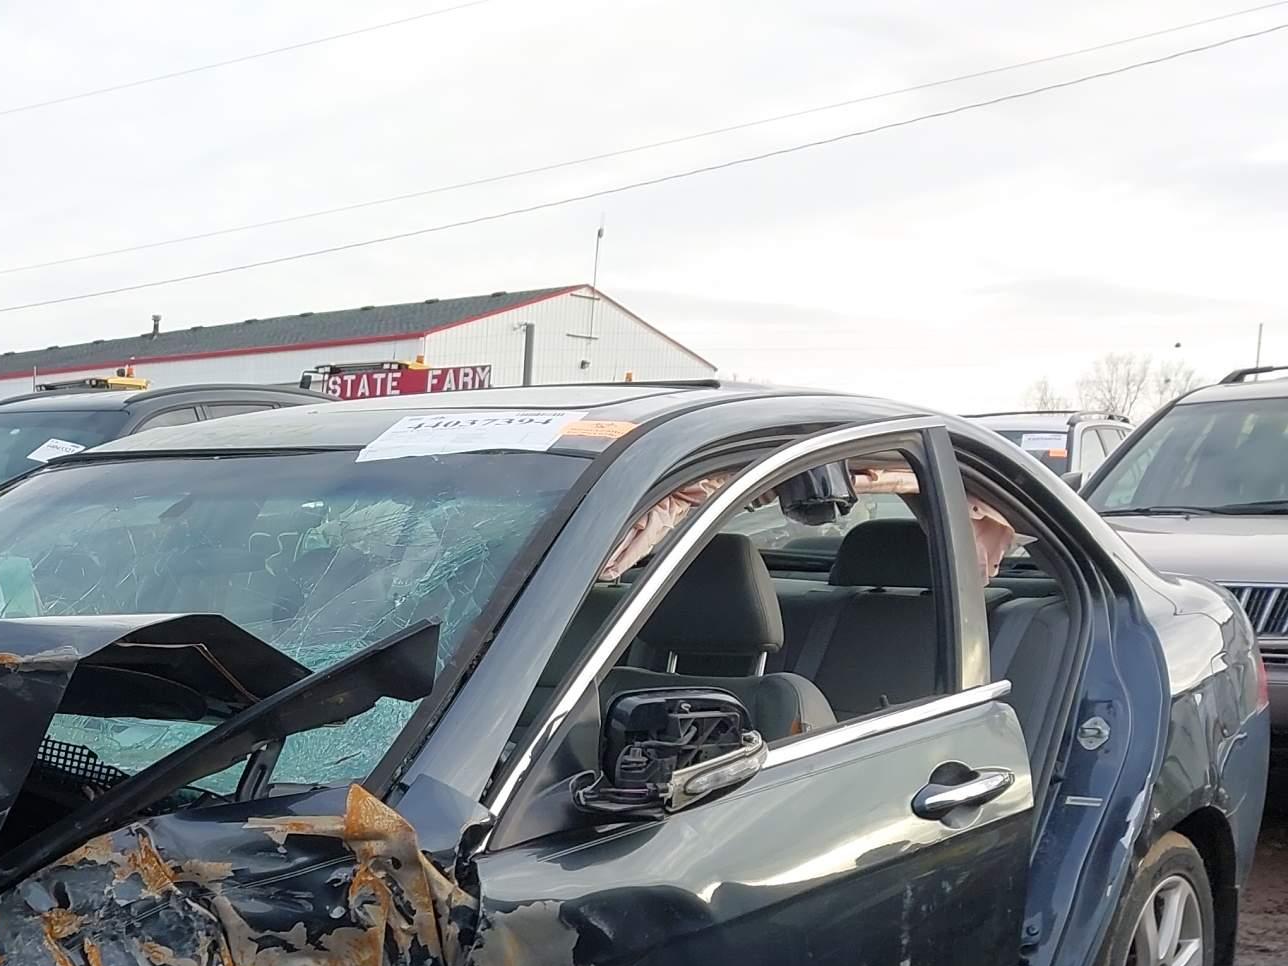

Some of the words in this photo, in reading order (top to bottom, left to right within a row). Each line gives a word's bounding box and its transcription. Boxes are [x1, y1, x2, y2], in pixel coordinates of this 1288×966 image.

[328, 372, 402, 398] STATE
[426, 366, 491, 393] FARM
[407, 417, 553, 430] 44037394
